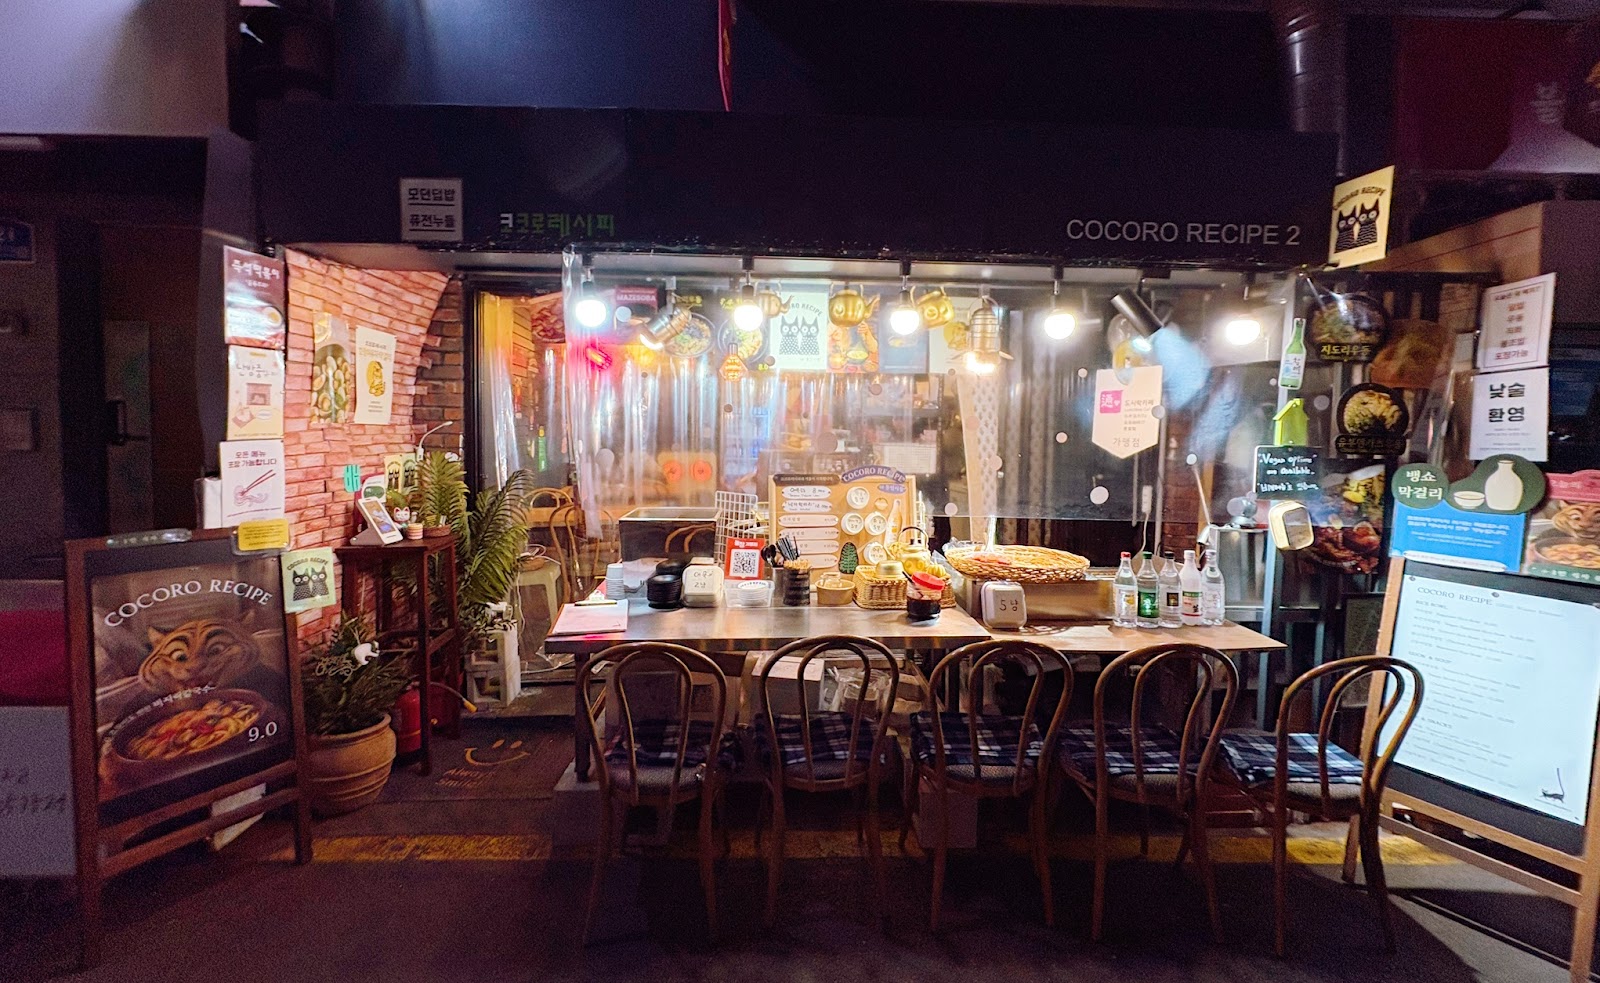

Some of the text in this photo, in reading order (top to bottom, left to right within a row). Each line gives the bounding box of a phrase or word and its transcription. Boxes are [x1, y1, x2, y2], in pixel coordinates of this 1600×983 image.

[500, 212, 615, 237] 코코로레시피
[1066, 219, 1300, 246] COCORO RECIPE 2
[801, 303, 823, 317] RECIPE
[1489, 382, 1526, 399] 낮술
[1489, 406, 1525, 422] 환영
[842, 467, 876, 483] COCORO
[1406, 470, 1437, 482] 뱅쇼
[1398, 485, 1443, 500] 막걸리
[104, 579, 273, 627] COCORO RECIPE
[1417, 586, 1493, 605] COCORO RECIPE
[248, 721, 278, 742] 9.0
